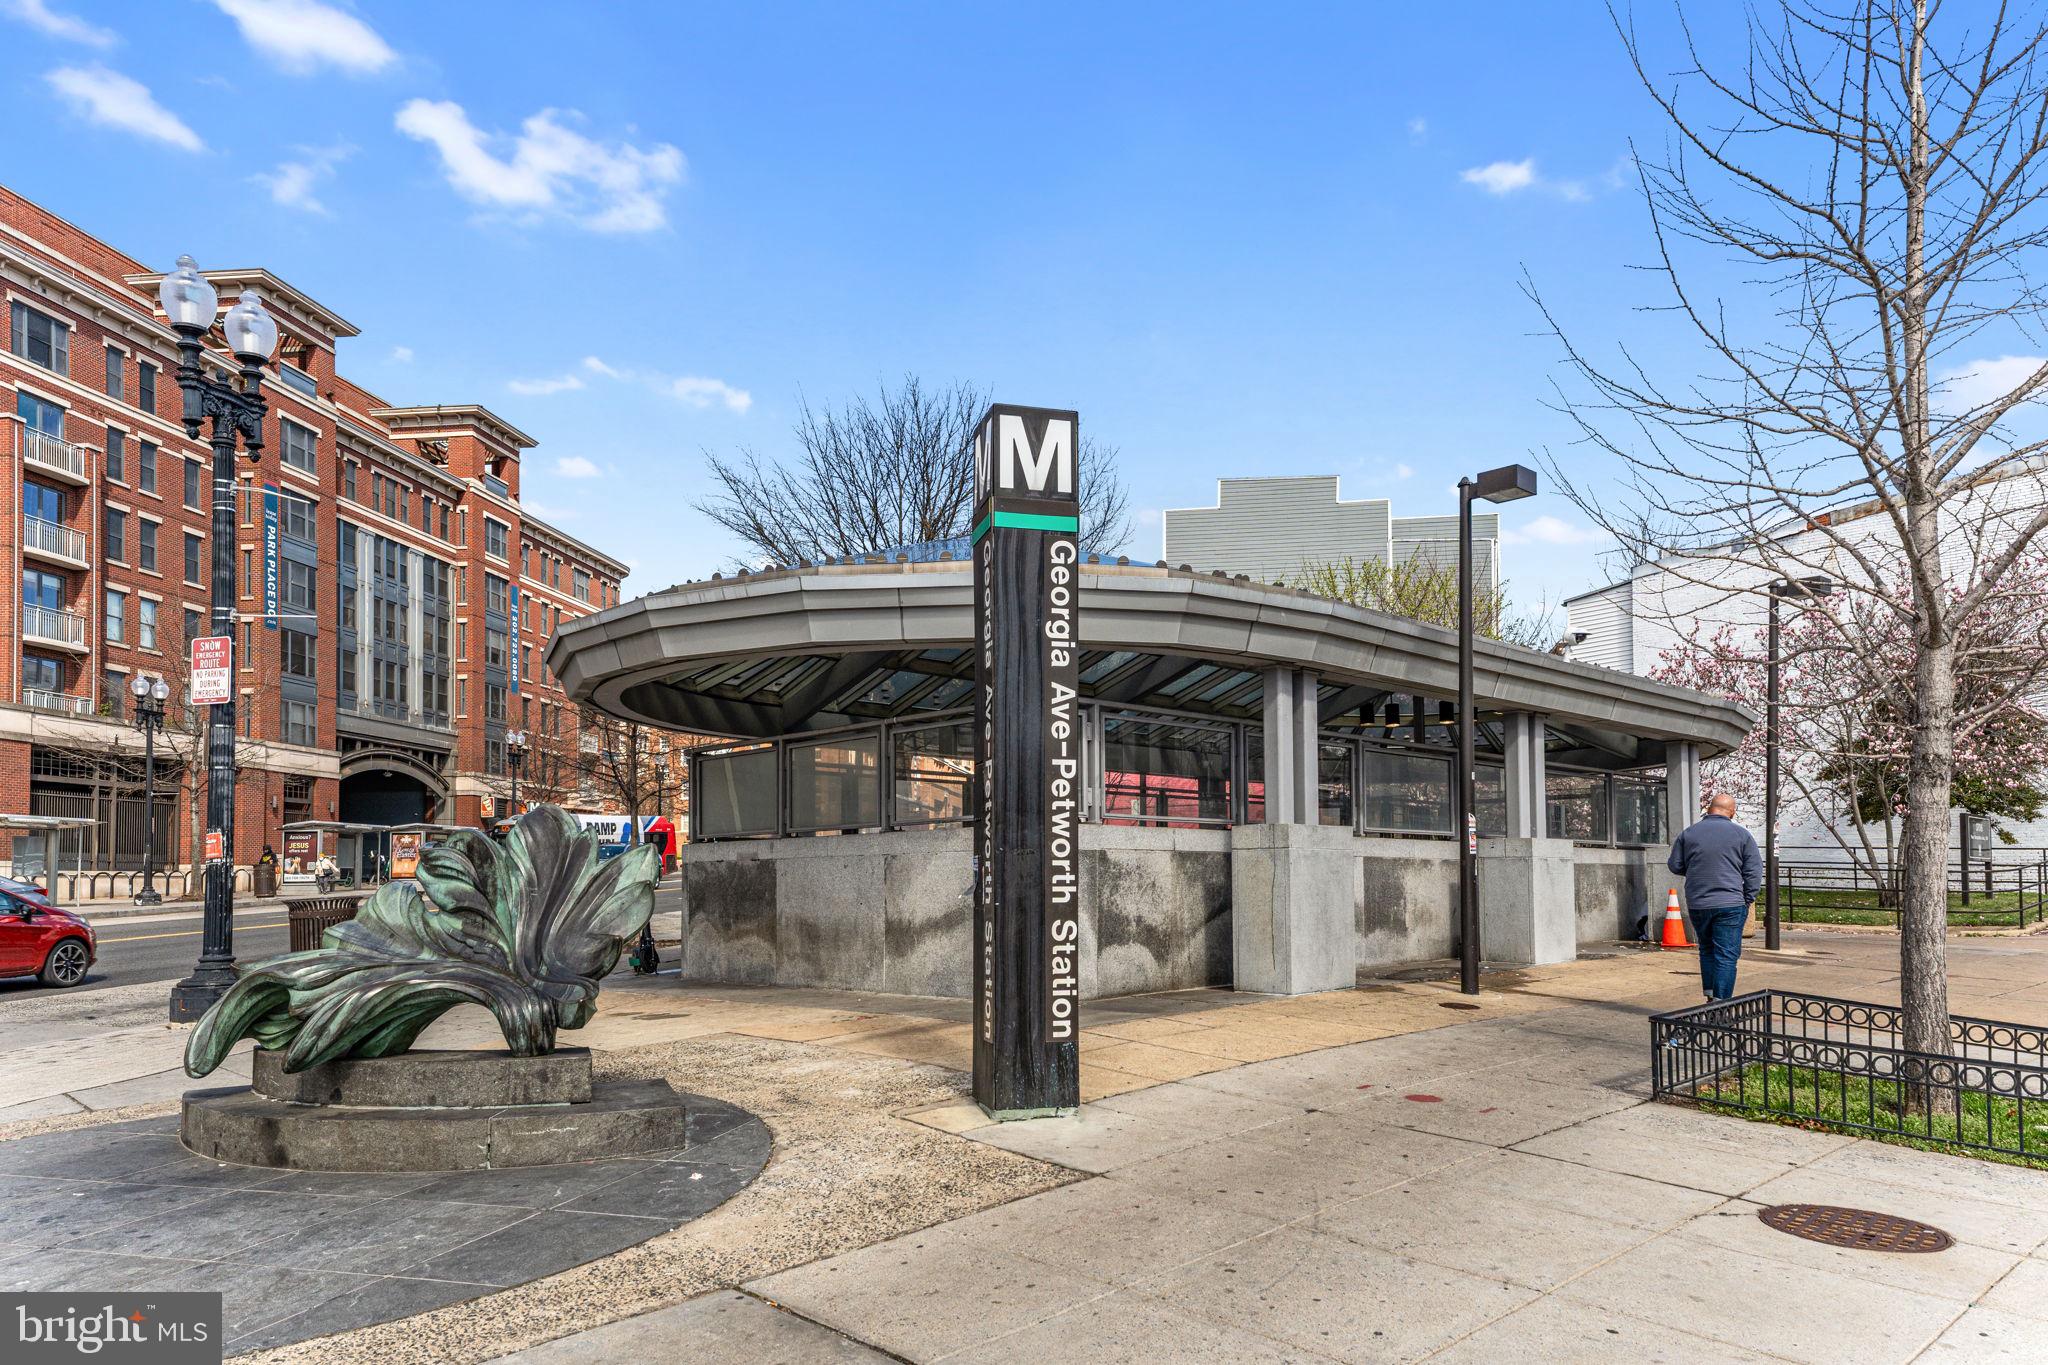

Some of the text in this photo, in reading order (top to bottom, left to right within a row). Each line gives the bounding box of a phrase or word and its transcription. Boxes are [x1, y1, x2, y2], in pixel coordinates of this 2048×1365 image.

[974, 417, 992, 508] M
[1000, 414, 1072, 493] M
[267, 525, 276, 558] PARK
[267, 559, 276, 598] PLACE
[984, 540, 993, 669] Georgia
[1045, 540, 1077, 667] Georgia
[195, 651, 226, 659] EMERGENCY
[200, 641, 221, 651] SNOW
[200, 659, 220, 668] ROUTE
[196, 670, 226, 679] NO PARKING
[200, 680, 220, 688] DURING
[195, 689, 226, 698] EMERGENCY
[984, 921, 993, 1039] Station
[1051, 920, 1078, 1037] Station
